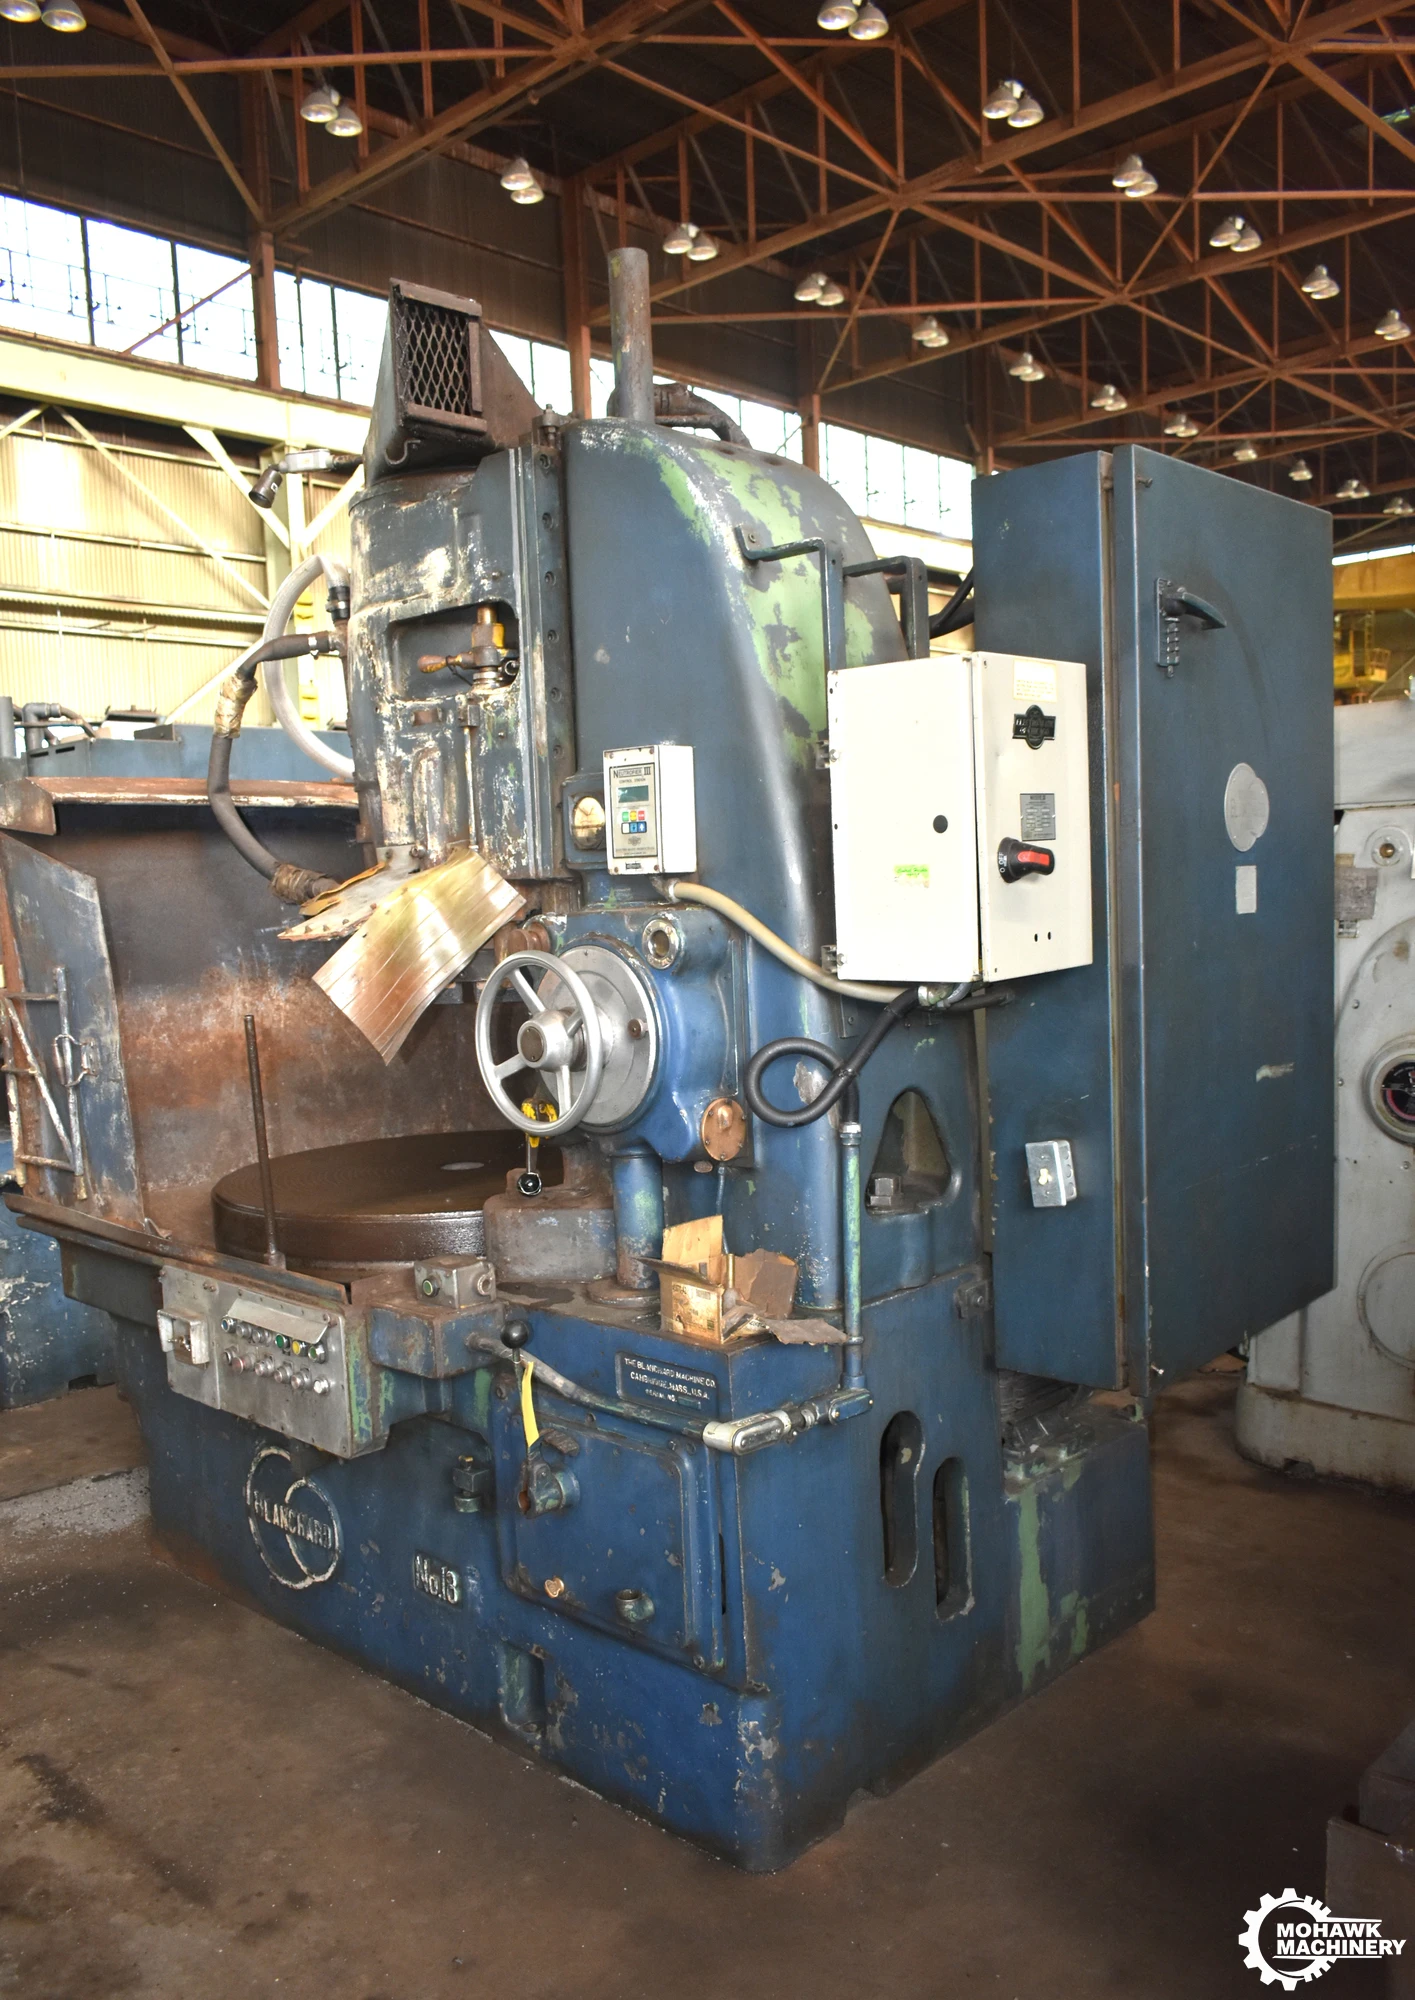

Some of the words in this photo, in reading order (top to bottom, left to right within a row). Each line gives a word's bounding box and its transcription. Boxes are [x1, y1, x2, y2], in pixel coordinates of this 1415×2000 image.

[624, 1357, 636, 1368] THE
[637, 1360, 675, 1378] BLANCHARD
[676, 1371, 705, 1386] MACHINE
